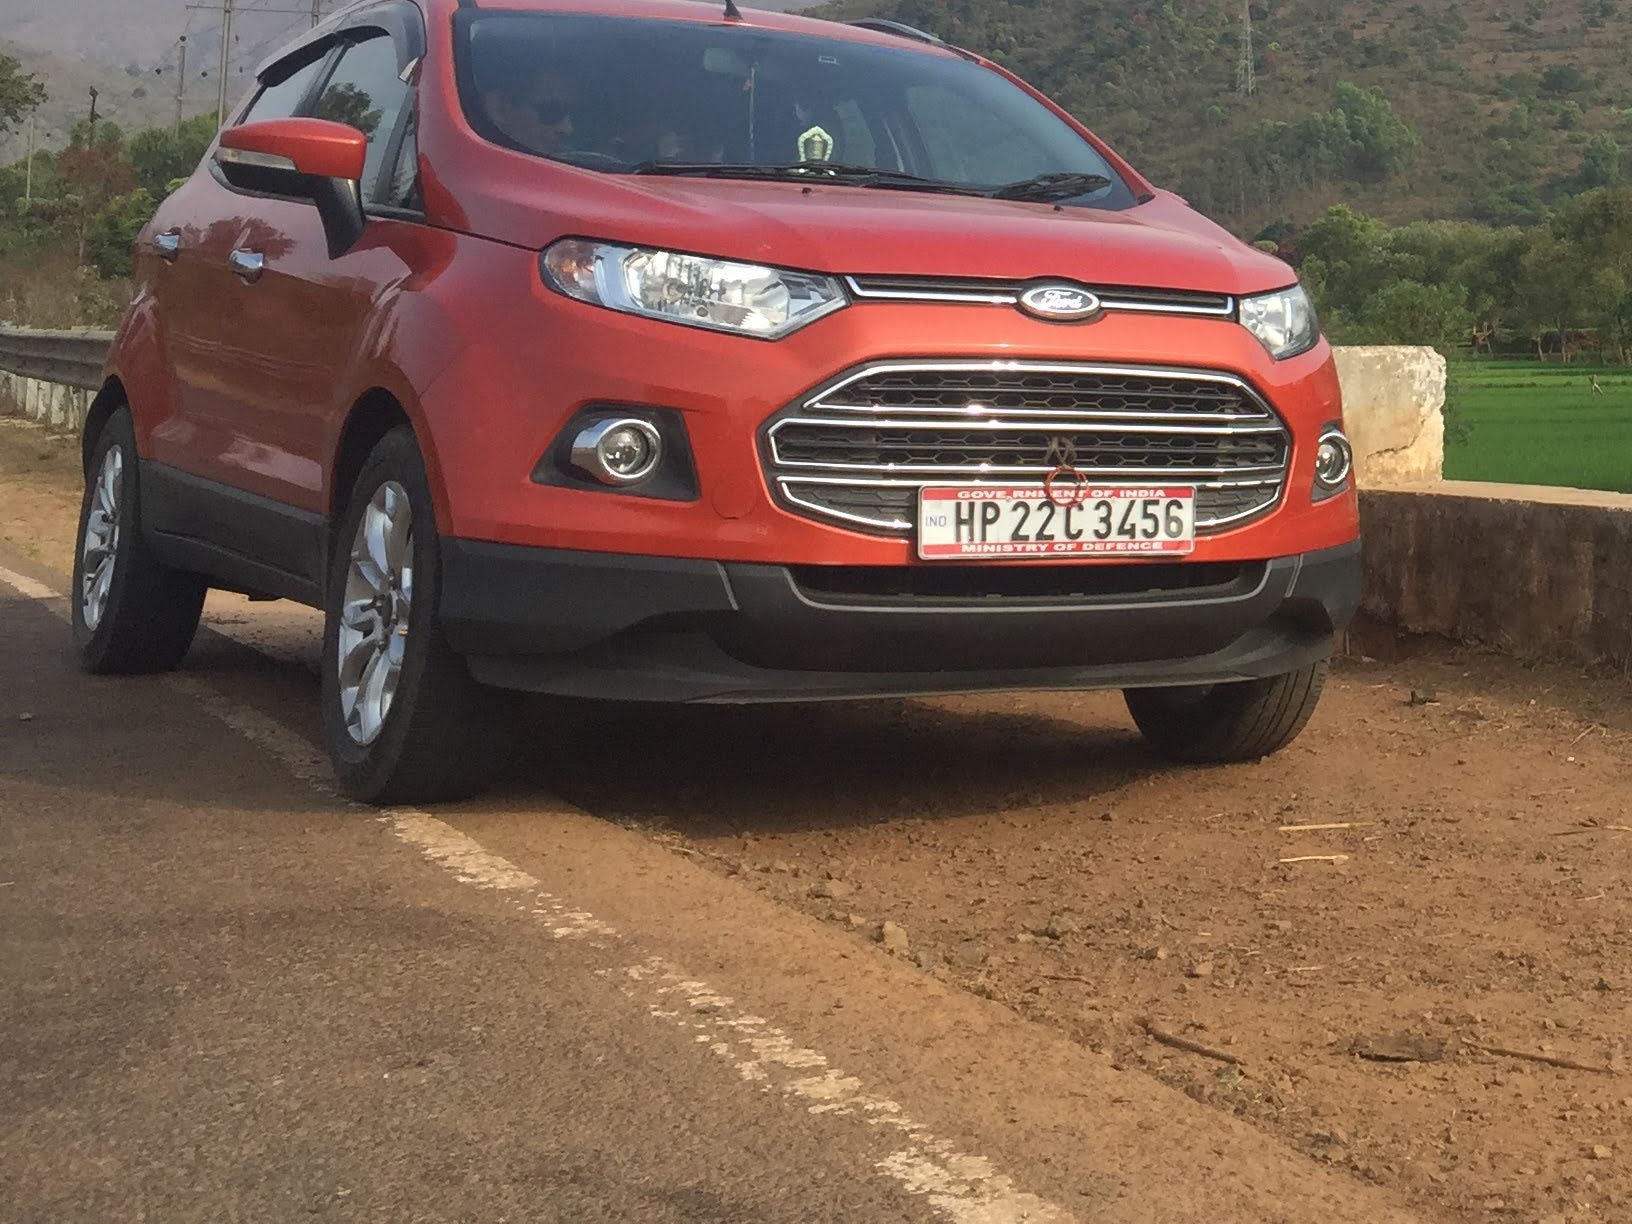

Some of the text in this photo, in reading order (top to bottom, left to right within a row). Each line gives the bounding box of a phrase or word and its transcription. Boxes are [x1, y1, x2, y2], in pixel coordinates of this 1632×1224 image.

[1090, 490, 1114, 498] OF
[1119, 489, 1166, 498] INDIA
[925, 515, 947, 527] IND
[961, 542, 1164, 553] MINISTRY OF DEFENCE
